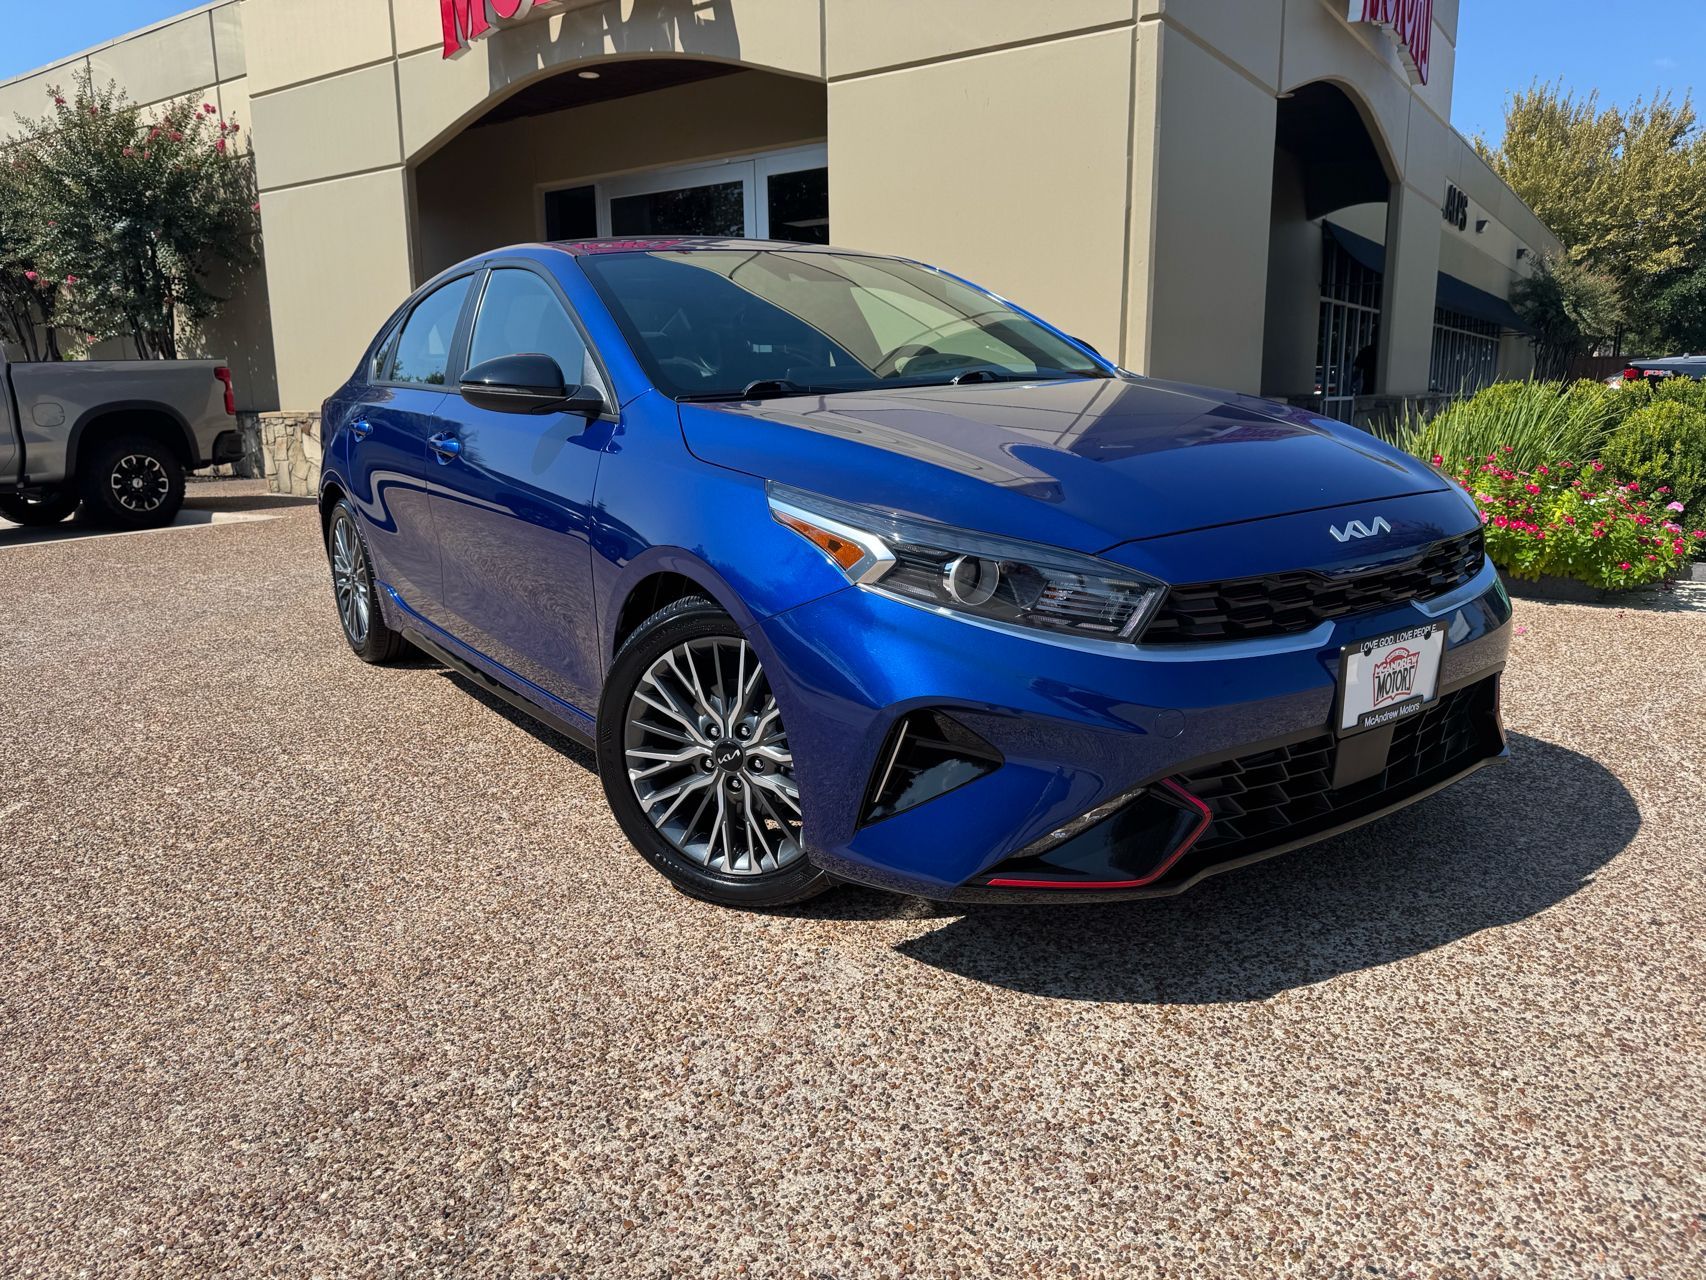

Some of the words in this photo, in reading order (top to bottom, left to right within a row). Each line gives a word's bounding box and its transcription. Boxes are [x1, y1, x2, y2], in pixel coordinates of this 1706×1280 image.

[1360, 639, 1379, 652] LOVE
[1396, 630, 1414, 643] LOVE
[1364, 710, 1399, 728] McAndrew
[1399, 702, 1421, 716] Motors
